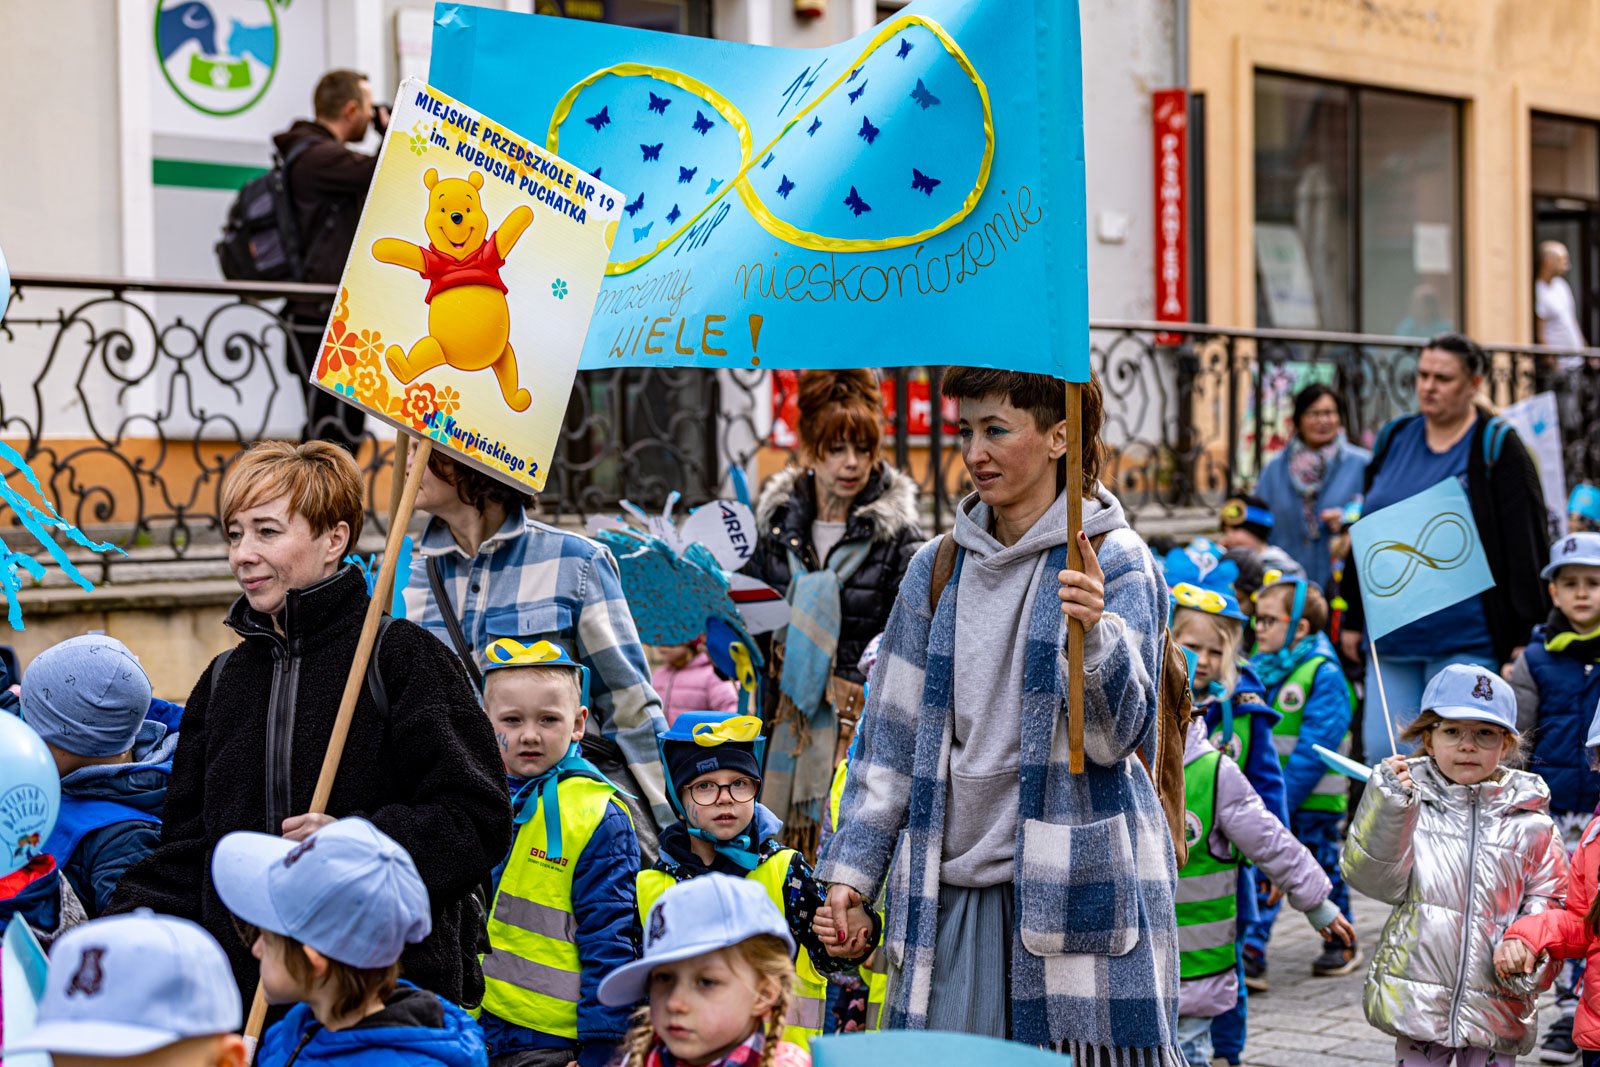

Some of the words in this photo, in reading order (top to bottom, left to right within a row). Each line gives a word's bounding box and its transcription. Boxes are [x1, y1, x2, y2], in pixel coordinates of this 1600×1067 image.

[415, 91, 480, 137] MIEJSKIE
[482, 127, 574, 189] PRZEDSZKOLE
[575, 179, 596, 202] NR
[599, 193, 615, 212] 19
[429, 127, 450, 151] im.
[455, 140, 516, 186] KUBUSIA
[518, 175, 587, 225] PUCHATKA
[734, 185, 1043, 303] nieskończenie
[1160, 132, 1182, 316] PASMANTERIA
[422, 410, 439, 429] ul.
[445, 417, 525, 472] Kurpińskiego
[528, 462, 539, 478] 2
[719, 499, 753, 560] AREN
